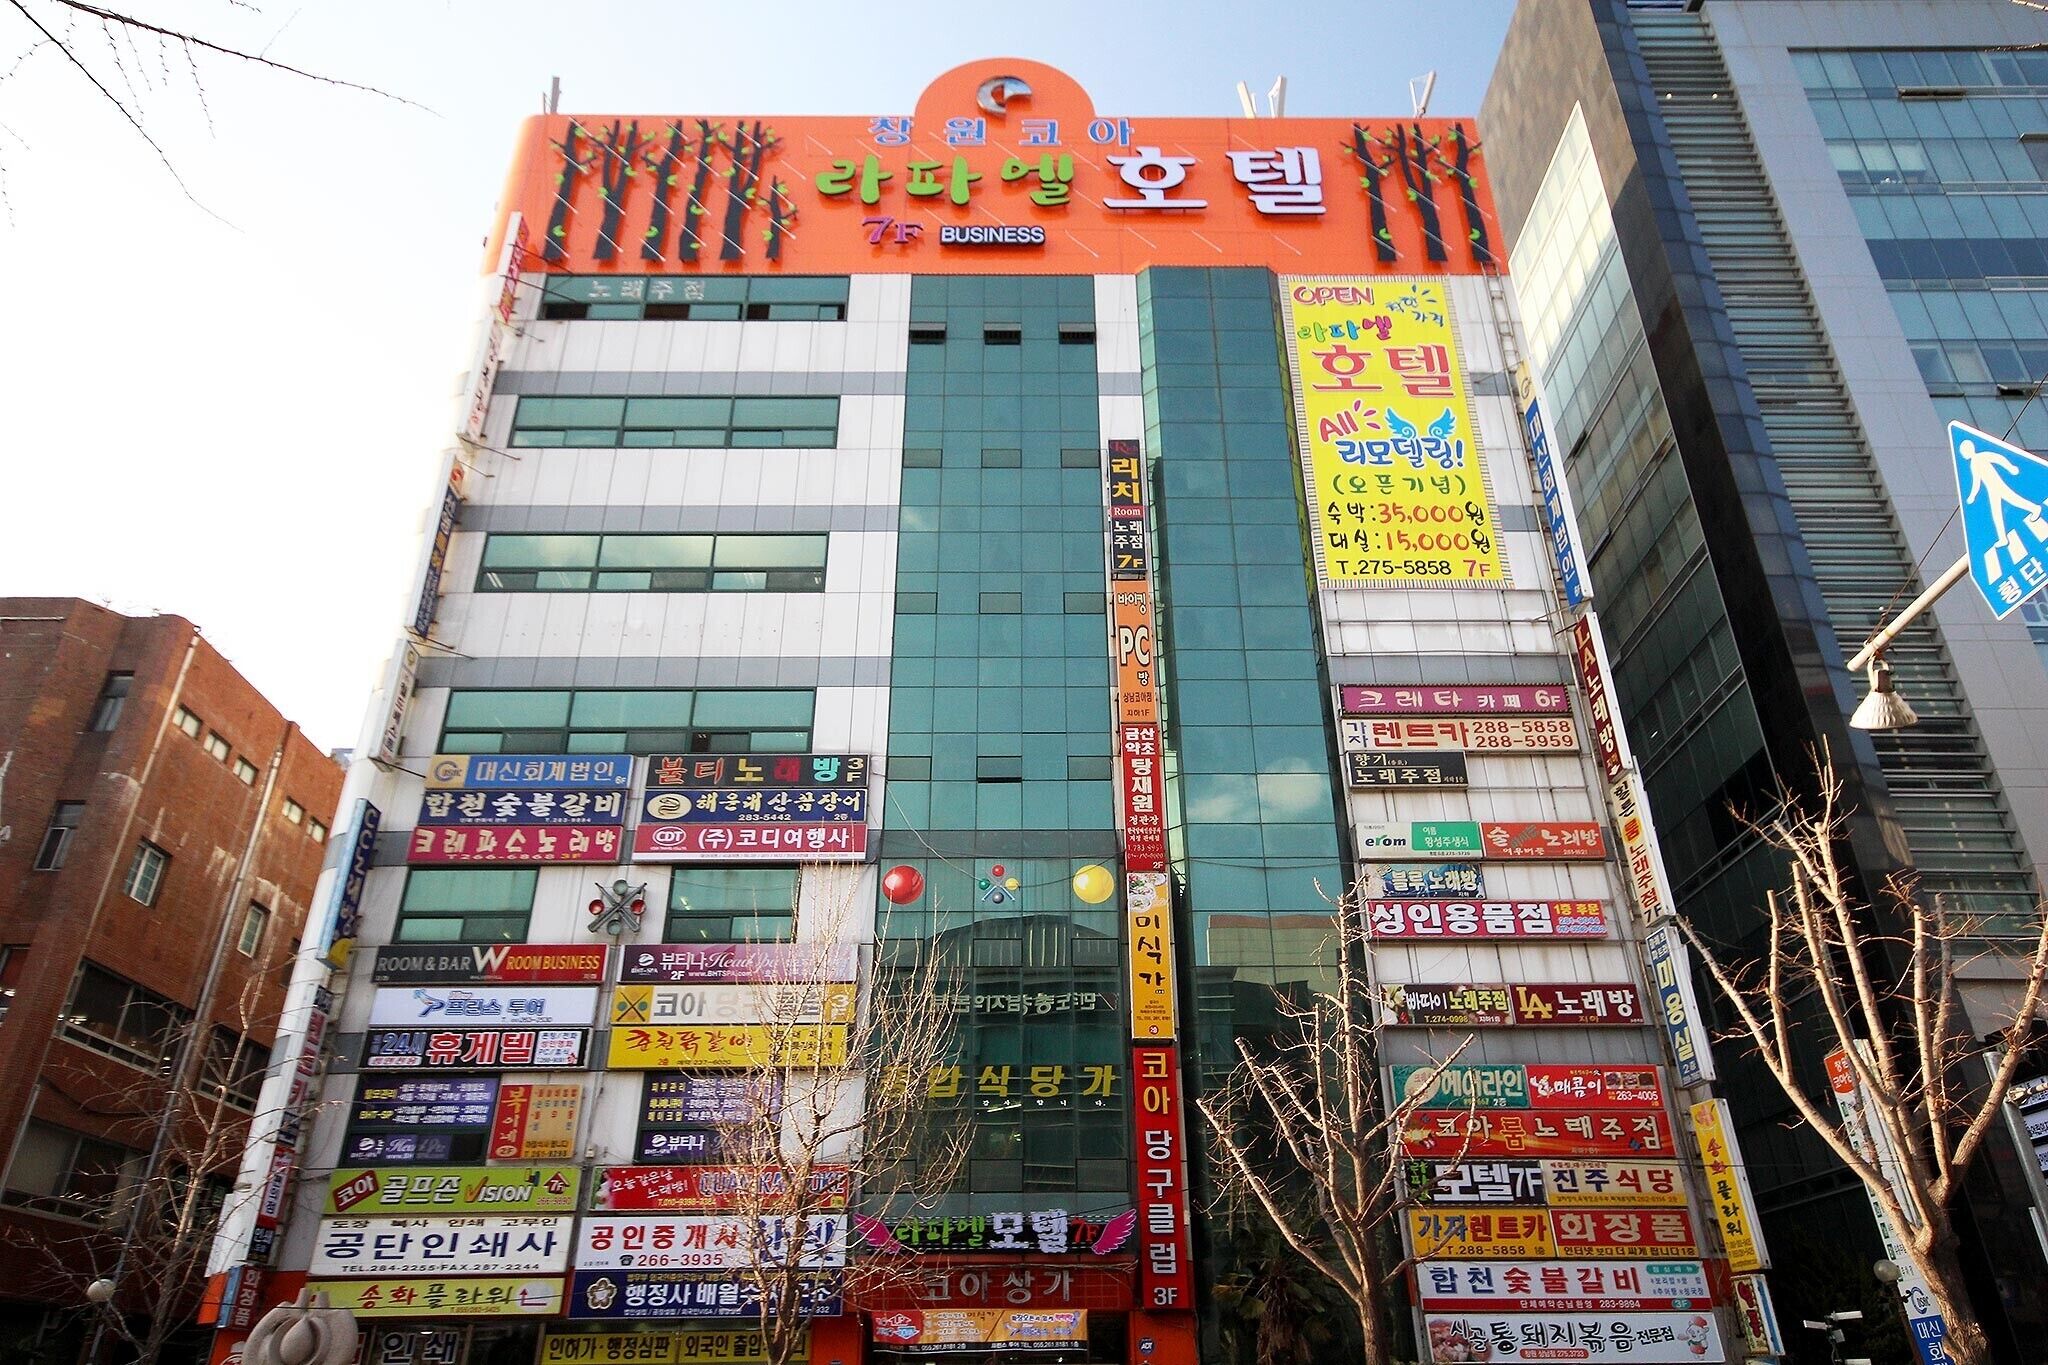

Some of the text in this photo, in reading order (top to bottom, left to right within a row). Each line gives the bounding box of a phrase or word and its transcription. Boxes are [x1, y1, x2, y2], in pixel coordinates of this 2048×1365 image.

[873, 116, 1135, 147] 창원코아
[815, 146, 1327, 215] 라파엘 호텔
[862, 217, 924, 246] 7F
[941, 225, 1045, 244] BUSINESS
[1293, 286, 1374, 305] OPEN
[1297, 315, 1393, 341] 라파엘
[1312, 344, 1455, 398] 호텔
[1319, 410, 1359, 442] All
[1337, 436, 1464, 469] 리모델링!
[1111, 458, 1140, 504] 리치
[1530, 410, 1576, 582] 대신회계법인
[1114, 507, 1141, 516] Room
[1114, 520, 1143, 534] 노래
[1114, 535, 1144, 549] 주점
[1117, 555, 1144, 568] 7F
[1336, 560, 1491, 577] T.275-5858 7F
[1117, 592, 1147, 614] 바이킹
[1119, 627, 1150, 666] PC
[1137, 672, 1149, 686] 방
[1577, 625, 1615, 753] LA 노래방
[1358, 690, 1561, 709] 크레타 카페 6F
[1125, 727, 1155, 741] 금산
[1347, 722, 1368, 748] 가자
[1372, 721, 1469, 748] 렌트카
[1472, 720, 1571, 733] 288-5858
[1125, 742, 1156, 756] 약초
[1475, 735, 1574, 748] 288-5959
[475, 761, 614, 783] 대신회계법인
[655, 756, 841, 785] 불티노래방
[1354, 753, 1387, 767] 향기
[1131, 758, 1154, 813] 탕재원
[1355, 768, 1441, 783] 노래주점
[425, 792, 622, 817] 합천숯불갈비
[738, 813, 791, 822] 283-5442
[415, 829, 616, 854] 크레파스노래방
[698, 827, 849, 849] (주)코디여행사
[1365, 834, 1407, 846] erom
[1541, 829, 1599, 847] 노래방
[1152, 861, 1164, 870] 2F
[1629, 844, 1660, 906] 노래주점
[1391, 870, 1478, 892] 블루 노래방
[1372, 902, 1554, 934] 성인용품점
[1643, 903, 1663, 924] 7F
[472, 946, 511, 972] W
[506, 955, 601, 970] ROOM BUSINESS
[660, 953, 706, 971] 뷰티나
[1135, 914, 1165, 986] 미식가
[376, 955, 471, 971] ROOM & BAR
[671, 971, 684, 980] 2F
[506, 998, 546, 1017] 투어
[654, 992, 706, 1017] 코아
[1449, 990, 1508, 1011] 노래주점
[1519, 986, 1634, 1019] LA 노래방
[1656, 957, 1695, 1062] 미용실
[1142, 1052, 1171, 1114] 코아
[1441, 1069, 1524, 1097] 헤어라인
[1616, 1090, 1658, 1101] 263-4005
[667, 1134, 705, 1151] 뷰티나
[380, 1174, 463, 1205] 골프존
[1433, 1164, 1543, 1201] 모텔 7F
[1552, 1169, 1674, 1194] 진주식당
[1145, 1130, 1177, 1274] 당구클럽
[331, 1219, 371, 1229] 도장
[448, 1218, 486, 1228] 인쇄
[501, 1218, 560, 1228] 고무인
[896, 1209, 1100, 1253] 라파엘 모텔 7F
[1561, 1213, 1687, 1244] 화장품
[323, 1231, 558, 1261] 공단인쇄사
[590, 1224, 740, 1251] 공인중개사
[638, 1254, 723, 1267] 266-3935
[1563, 1246, 1595, 1256] 인터넷
[921, 1269, 1074, 1303] 코아상가
[1430, 1266, 1641, 1295] 합천숯불갈비
[357, 1283, 513, 1310] 송화플라워
[625, 1282, 691, 1307] 행정사
[1154, 1288, 1178, 1305] 3F
[1450, 1318, 1675, 1353] 시골 통돼지볶음 전문점
[1917, 1320, 1942, 1339] 대신
[381, 1331, 460, 1365] 인쇄
[606, 1335, 670, 1358] 행정심판
[685, 1335, 729, 1358] 외국인
